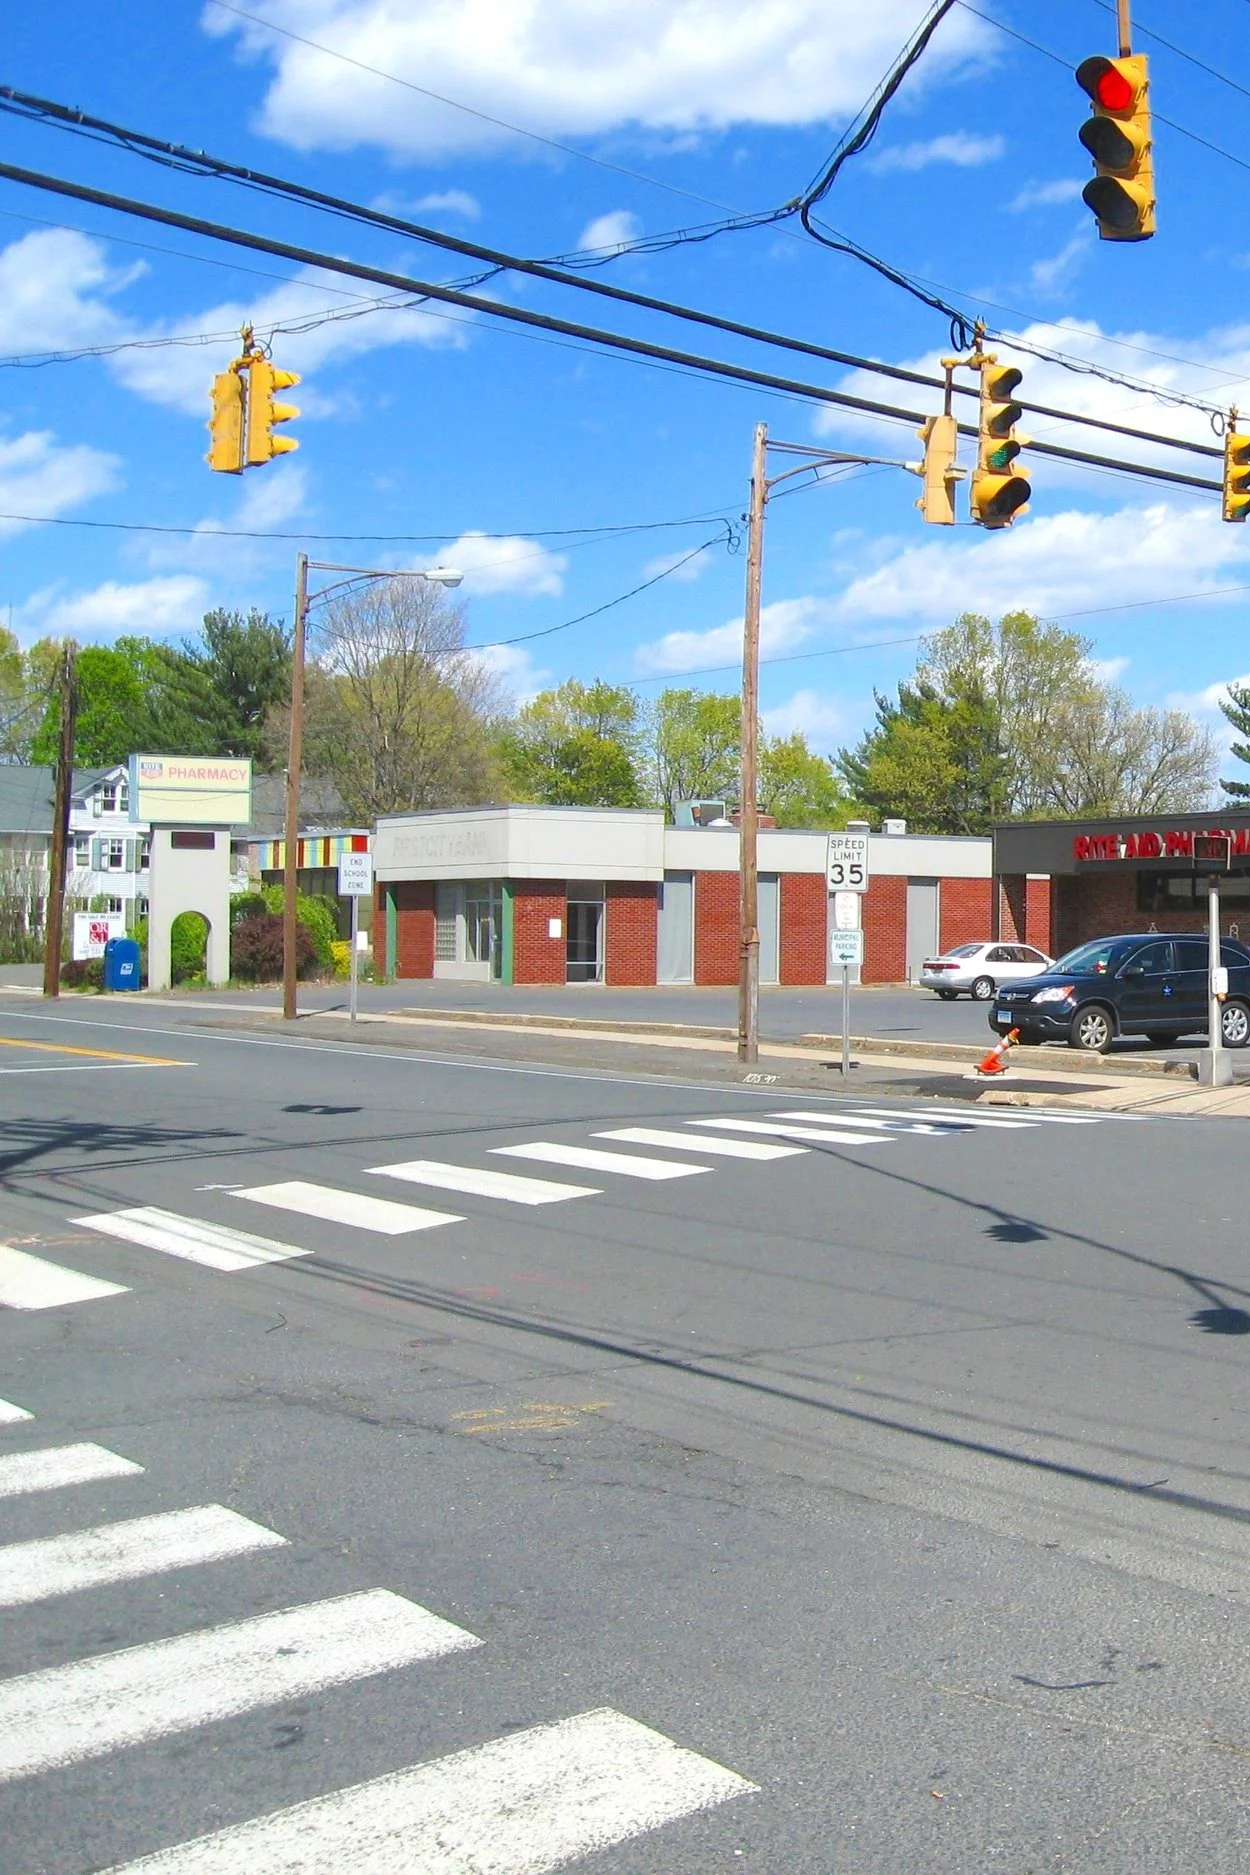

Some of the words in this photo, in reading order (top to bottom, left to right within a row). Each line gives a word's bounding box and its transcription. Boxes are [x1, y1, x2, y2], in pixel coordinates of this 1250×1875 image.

[168, 766, 247, 781] PHARMACY
[830, 839, 865, 849] SPEED
[1074, 833, 1118, 860] RITE
[1124, 832, 1158, 859] AID
[833, 852, 862, 861] LIMIT
[350, 858, 363, 866] END
[343, 869, 368, 878] SCHOOL
[830, 863, 863, 885] 35
[347, 881, 364, 889] ZONE
